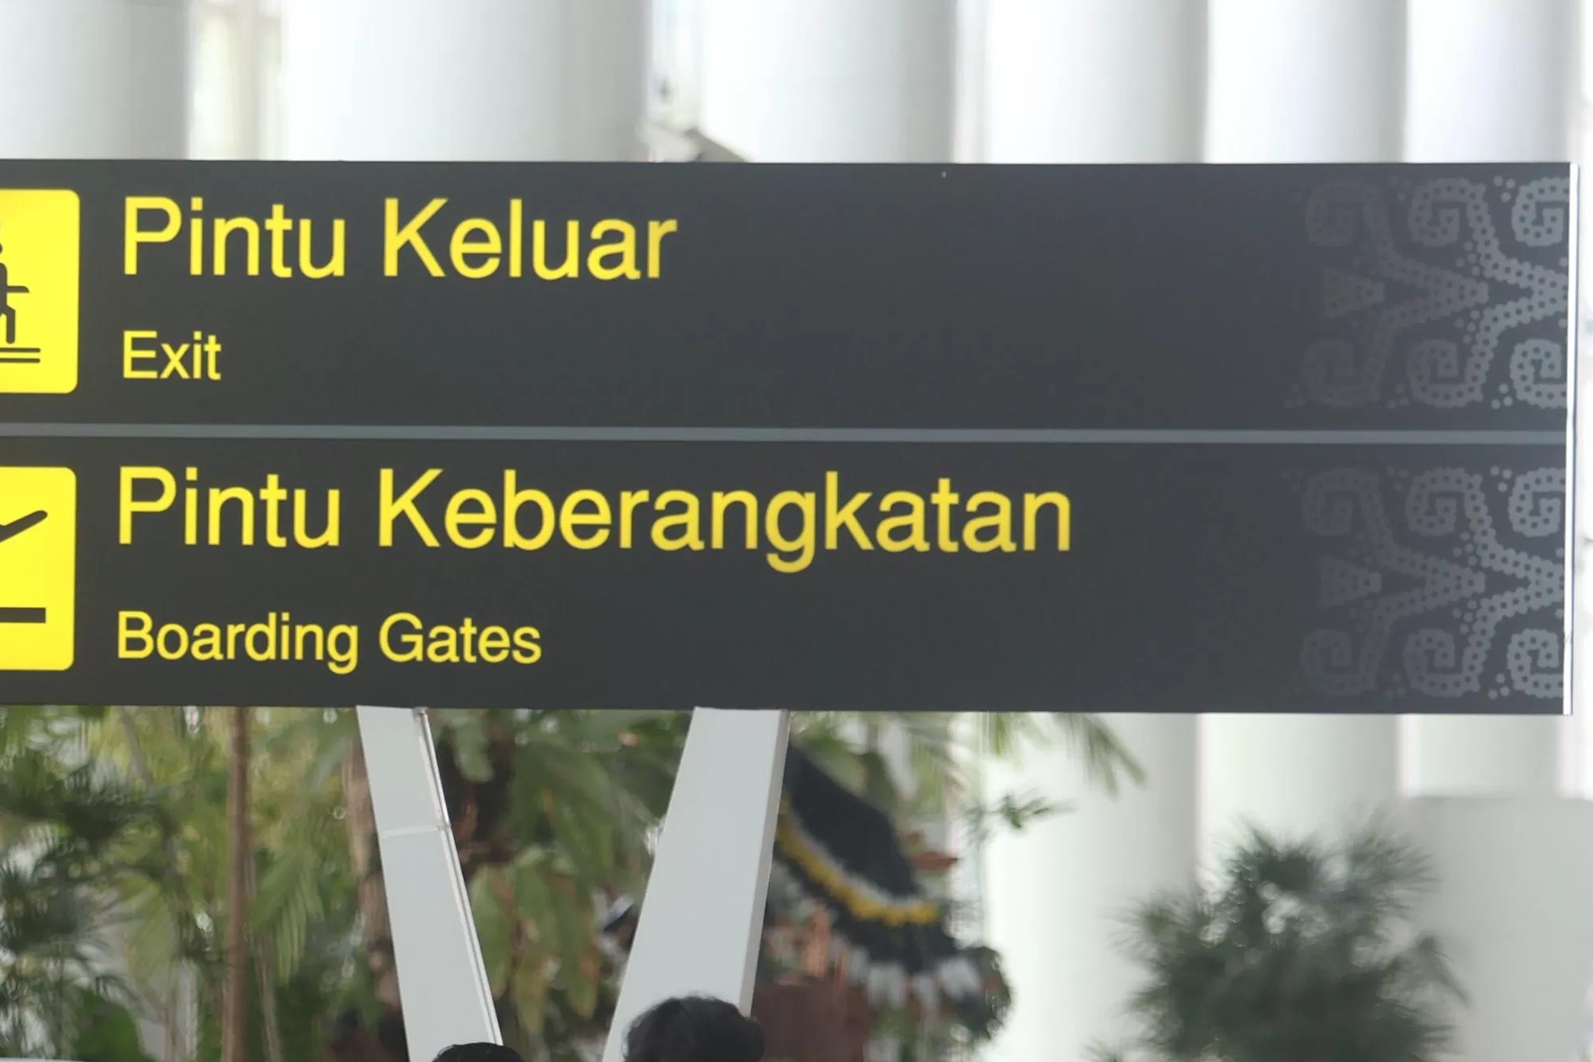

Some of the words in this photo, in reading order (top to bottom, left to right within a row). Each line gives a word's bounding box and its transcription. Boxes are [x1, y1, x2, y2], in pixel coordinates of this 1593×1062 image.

[122, 195, 348, 280] Pintu
[383, 197, 679, 281] Keluar
[121, 329, 224, 382] Exit
[117, 464, 343, 550] Pintu
[377, 467, 1073, 575] Keberangkatan
[117, 609, 361, 676] Boarding
[378, 610, 544, 666] Gates
